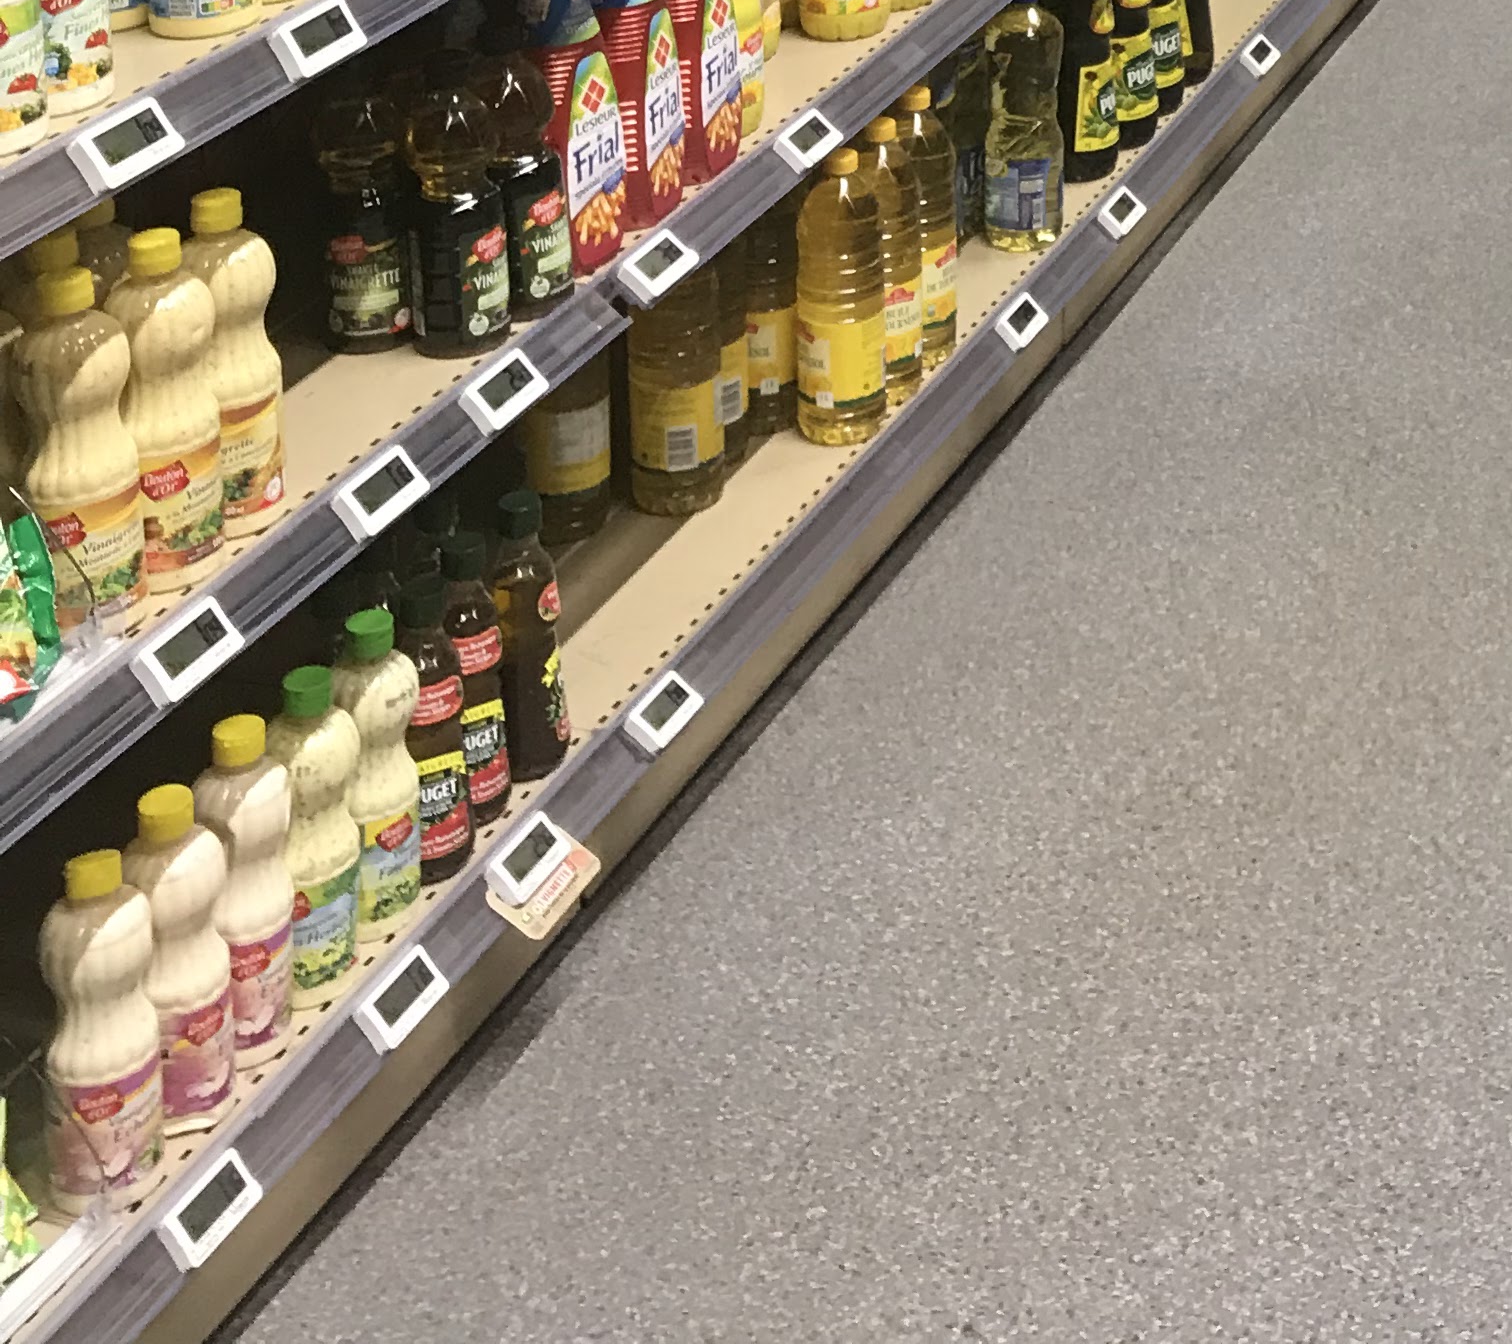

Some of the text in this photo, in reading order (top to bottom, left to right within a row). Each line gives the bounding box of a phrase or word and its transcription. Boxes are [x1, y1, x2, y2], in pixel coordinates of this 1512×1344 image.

[705, 41, 738, 96] Frial
[648, 86, 681, 137] Frial
[571, 120, 620, 186] Frial
